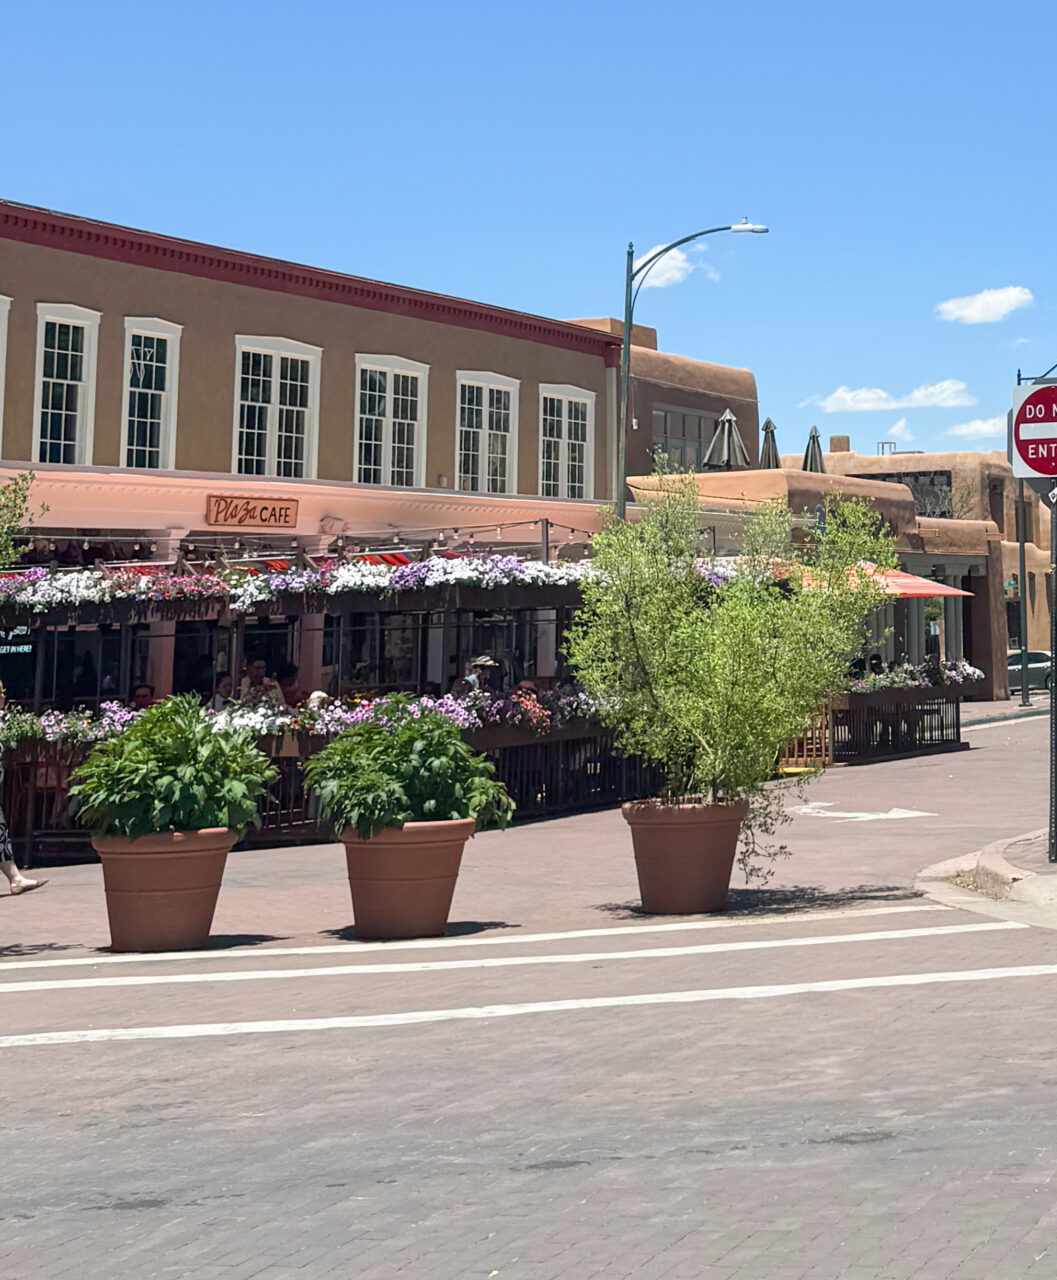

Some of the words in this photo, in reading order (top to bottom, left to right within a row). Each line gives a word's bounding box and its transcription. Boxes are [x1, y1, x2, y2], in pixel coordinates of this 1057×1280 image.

[1026, 405, 1045, 418] DO
[214, 498, 258, 524] Plaza
[260, 506, 291, 524] CAFE
